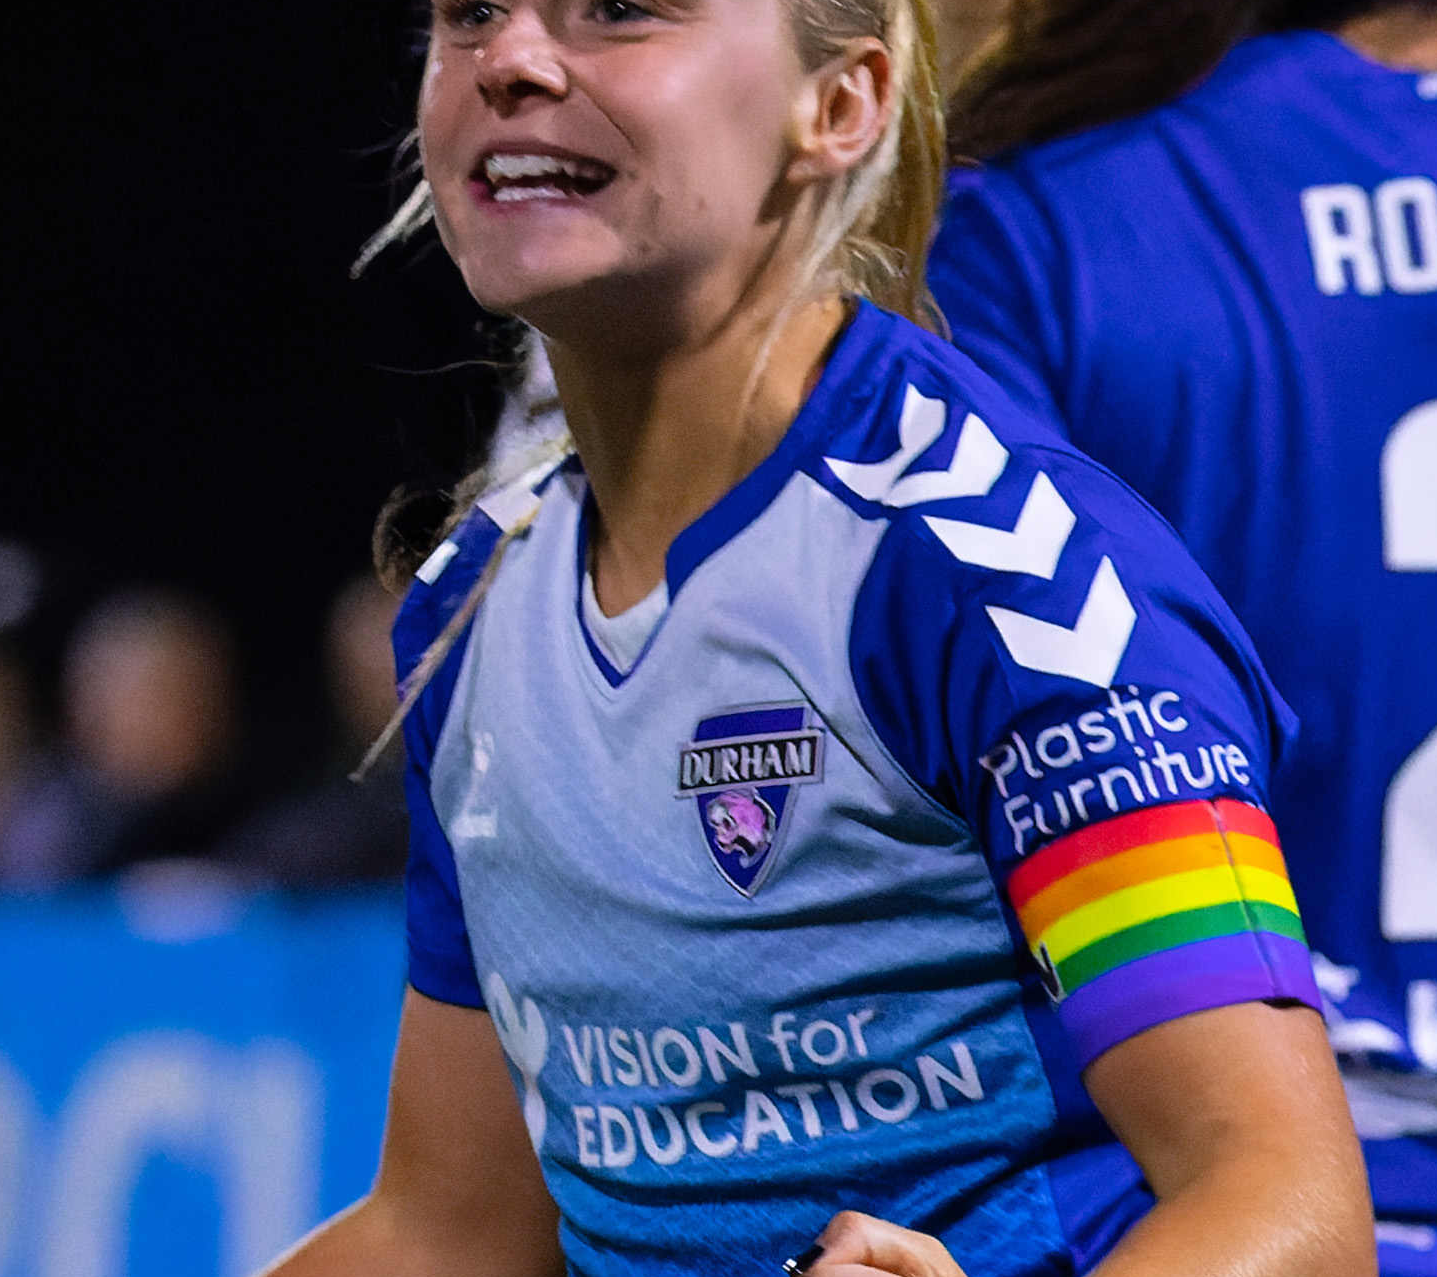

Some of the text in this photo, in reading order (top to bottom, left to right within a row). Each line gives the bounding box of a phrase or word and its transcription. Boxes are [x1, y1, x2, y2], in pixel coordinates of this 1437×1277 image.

[682, 739, 812, 787] DURHAM
[978, 685, 1189, 799] Plastic
[1003, 740, 1251, 856] Furniture
[563, 1008, 875, 1088] VISION for
[573, 1042, 984, 1169] EDUCATION
